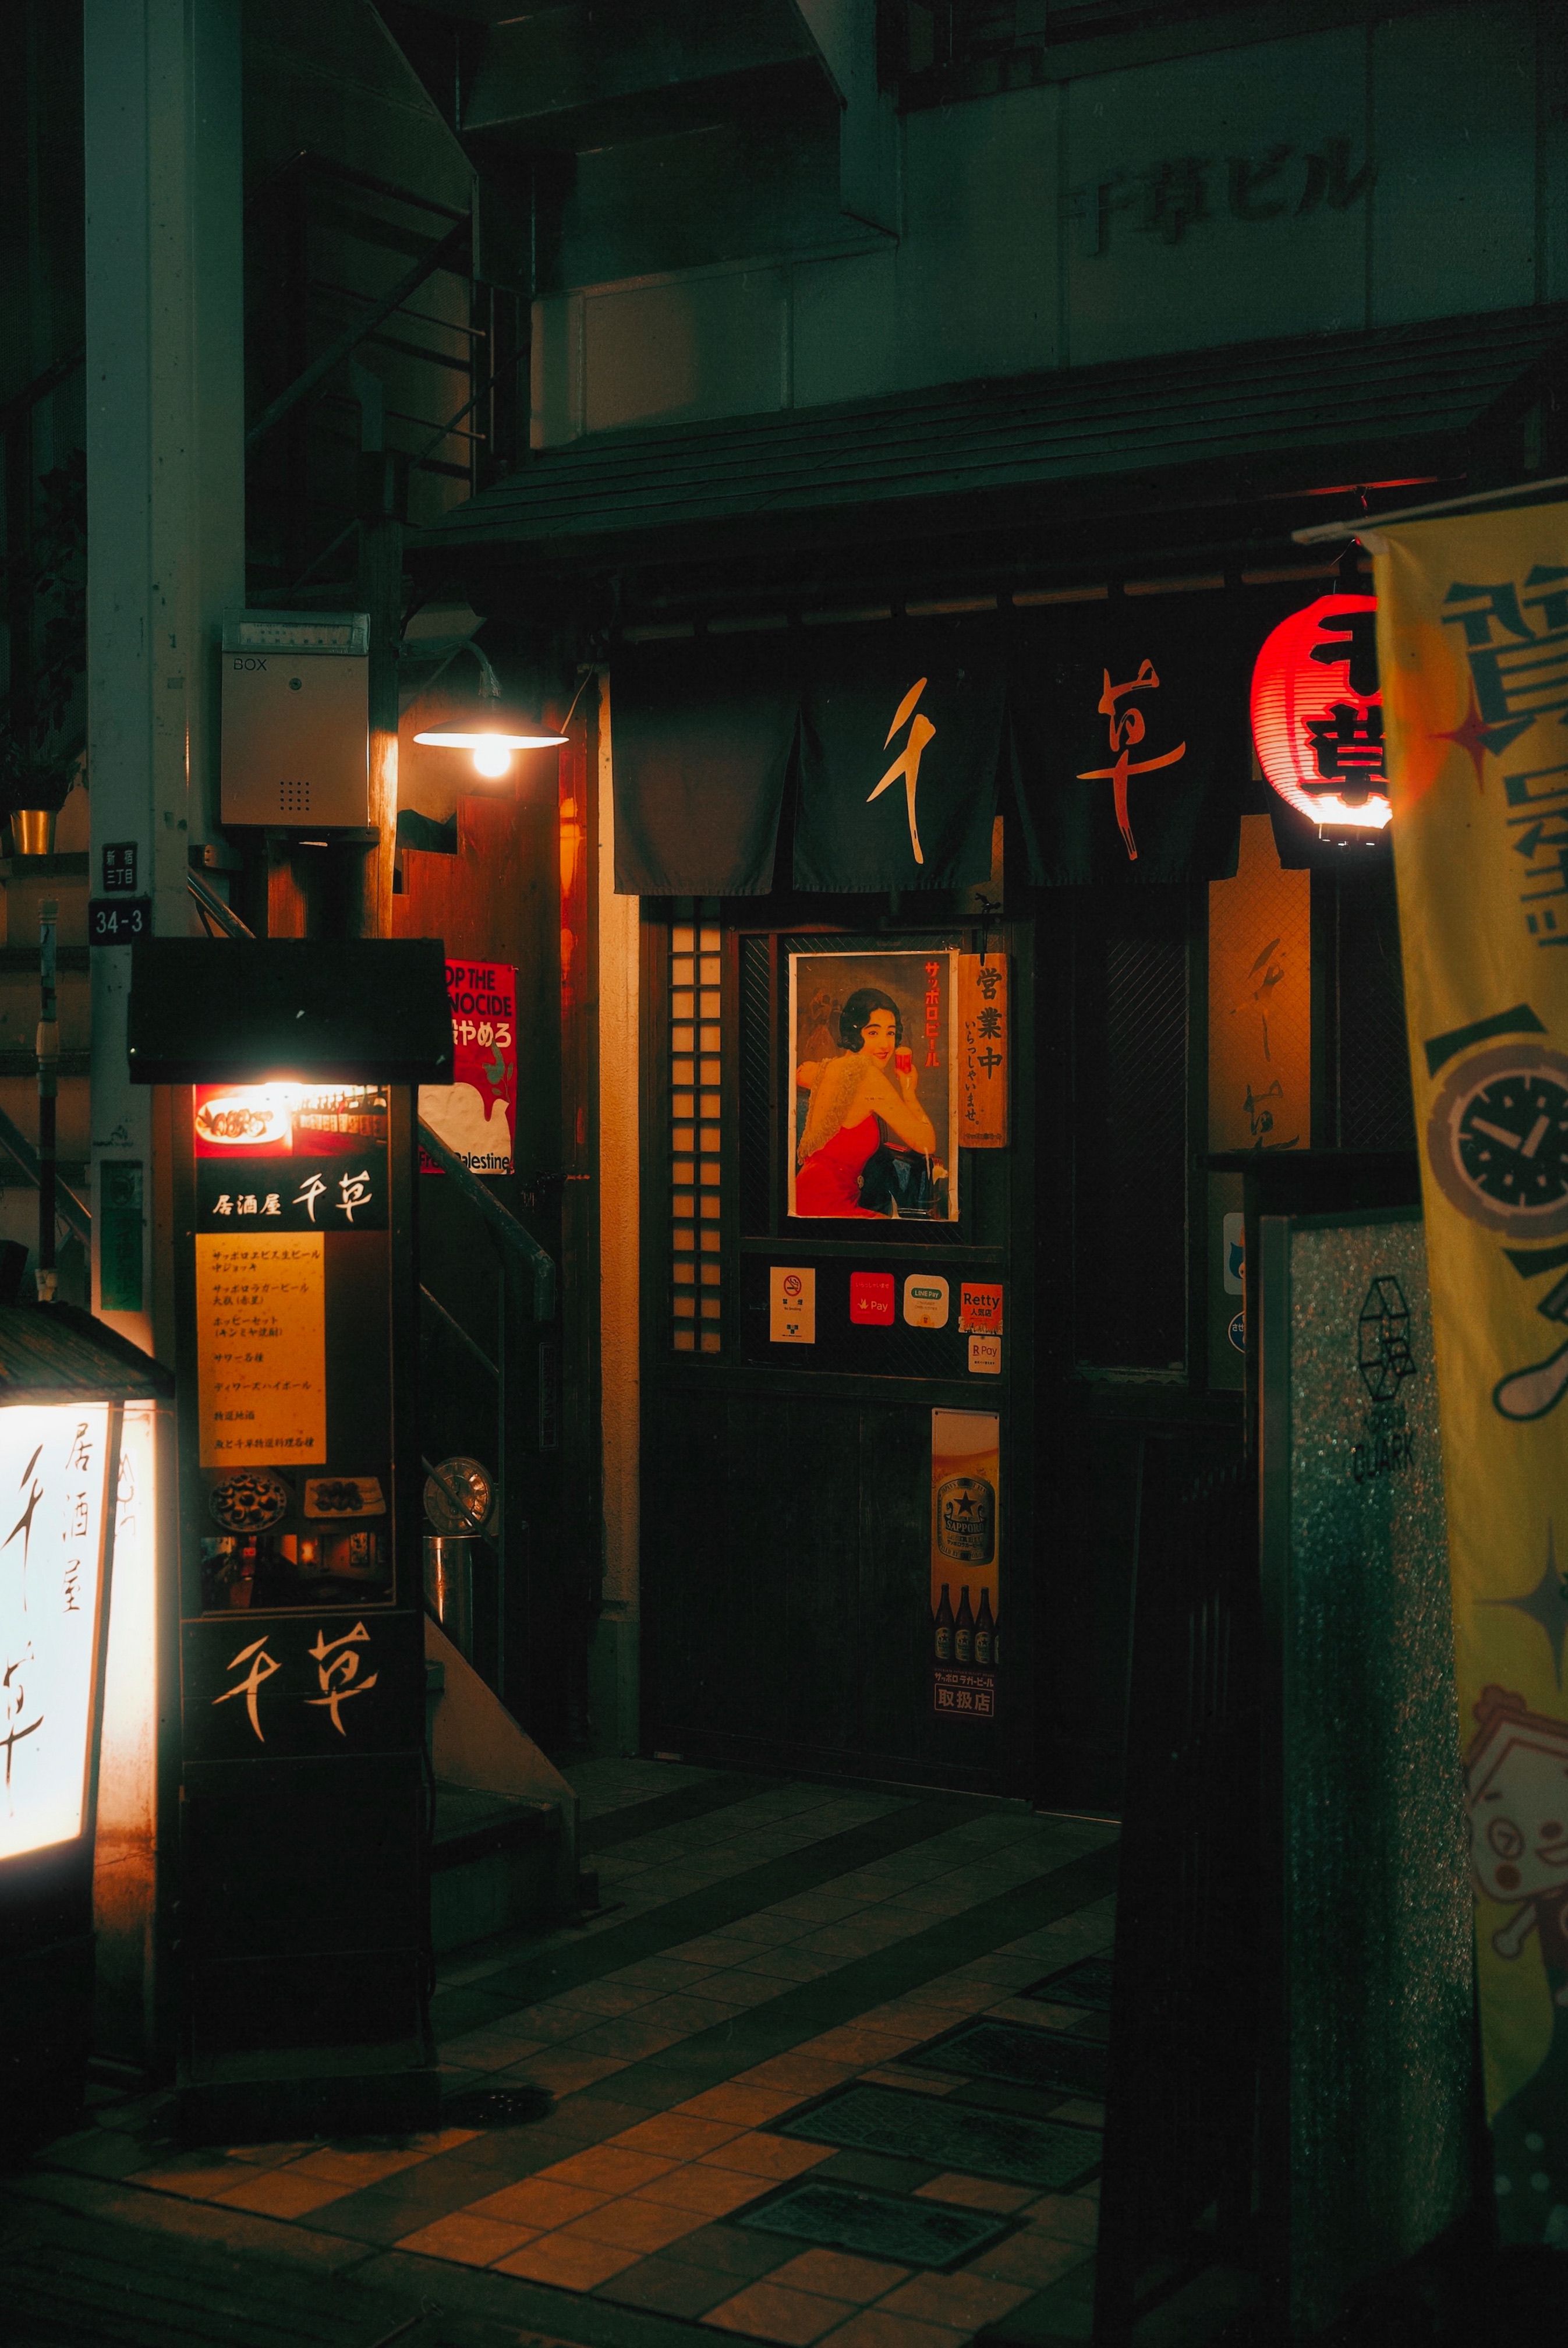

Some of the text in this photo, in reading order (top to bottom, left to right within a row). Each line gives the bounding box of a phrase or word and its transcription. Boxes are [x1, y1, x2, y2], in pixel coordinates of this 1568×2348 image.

[233, 658, 267, 671] BOX
[866, 658, 1187, 865] 千草
[106, 849, 134, 866] 新宿
[106, 868, 133, 885] 三丁目
[95, 909, 143, 934] 34-3
[444, 966, 494, 991] OP THE
[448, 991, 512, 1017] NOCIDE
[925, 961, 940, 1067] サッポロビール
[452, 1019, 512, 1048] やめろ
[976, 967, 1003, 1080] 営業中
[211, 1169, 373, 1223] 居酒屋 千草
[870, 1300, 889, 1313] Pay
[929, 1290, 940, 1299] Pay
[963, 1292, 1000, 1310] Retty
[970, 1308, 992, 1317] 人気店
[972, 1345, 997, 1357] R Pay
[61, 1422, 93, 1613] 居酒屋
[946, 1520, 984, 1533] SAPPORO
[211, 1620, 378, 1743] 千草
[938, 1688, 991, 1713] 取扱店
